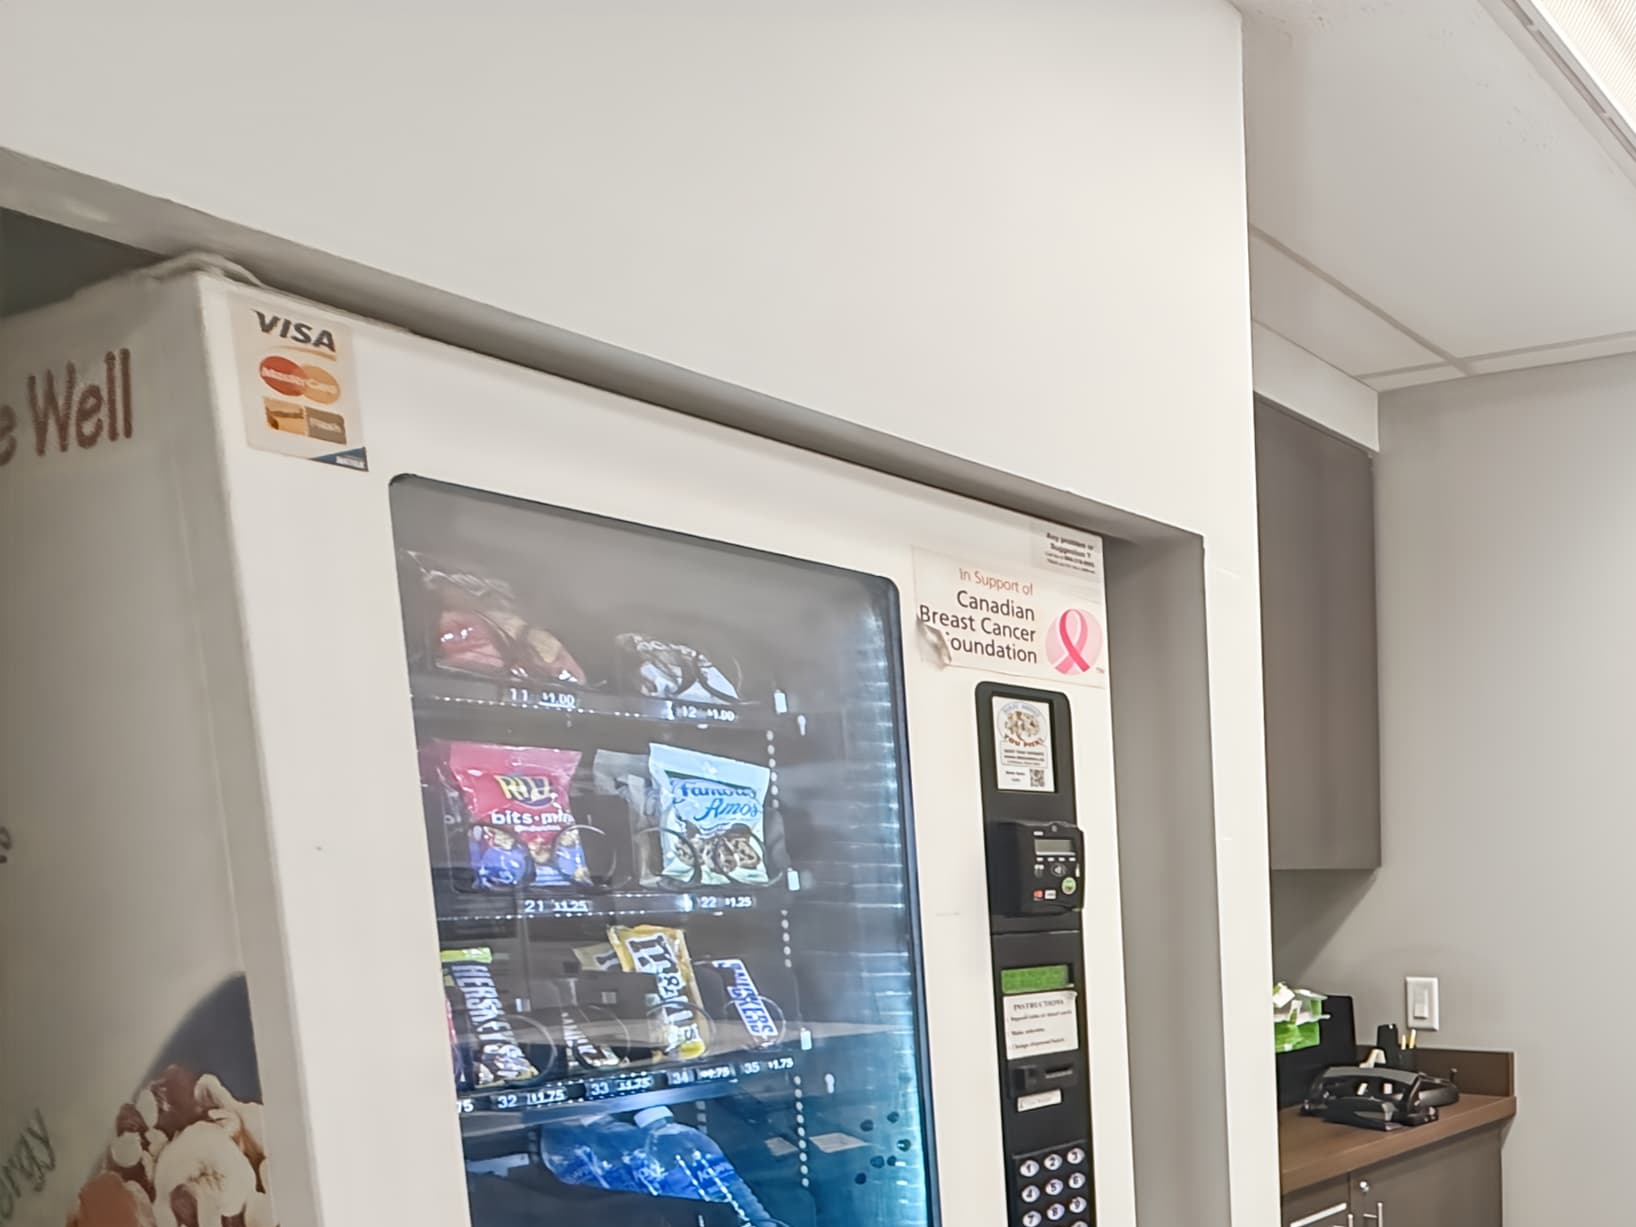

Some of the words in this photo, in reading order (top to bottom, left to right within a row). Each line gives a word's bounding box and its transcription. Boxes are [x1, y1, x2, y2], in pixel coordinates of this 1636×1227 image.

[252, 309, 336, 353] VISA
[27, 348, 133, 457] Well
[959, 568, 971, 581] In
[974, 569, 1020, 593] Support
[957, 590, 1036, 621] Canadian
[919, 604, 976, 631] Breast
[980, 616, 1037, 642] Cancer
[946, 631, 1038, 664] oundation
[681, 705, 697, 718] 12
[693, 798, 759, 821] Amos
[525, 900, 543, 912] 21
[701, 897, 716, 908] 22
[744, 1061, 760, 1074] 35
[673, 1072, 688, 1084] 34
[591, 1082, 608, 1096] 33
[498, 1096, 517, 1108] 32
